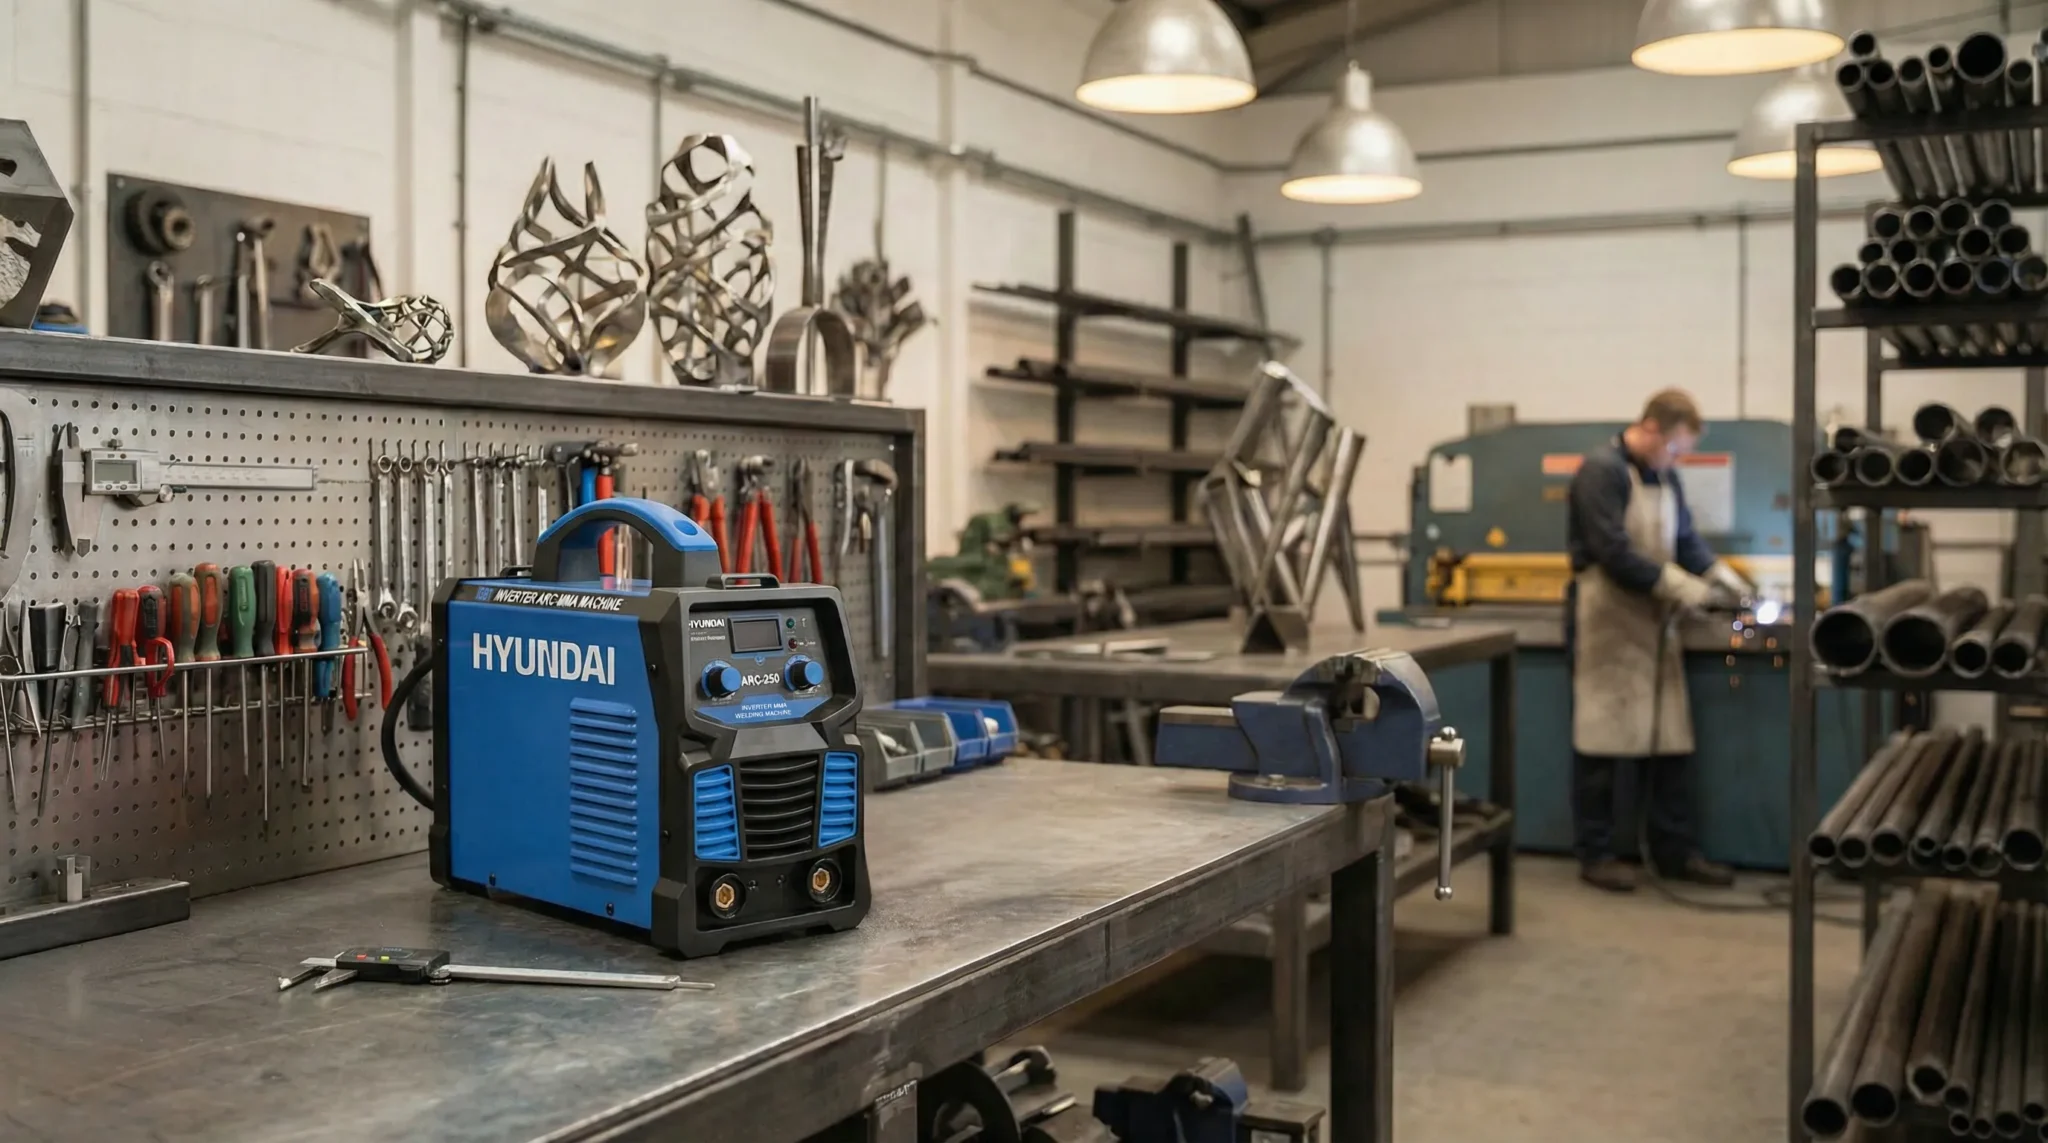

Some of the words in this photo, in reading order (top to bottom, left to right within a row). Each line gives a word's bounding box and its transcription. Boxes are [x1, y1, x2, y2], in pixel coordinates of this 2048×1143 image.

[493, 588, 538, 605] INVERTER
[578, 595, 624, 611] MACHINE
[473, 632, 615, 686] HYUNDAI
[741, 672, 780, 687] ARC-250
[735, 711, 764, 719] WELDING
[765, 709, 792, 717] MACHINE
[741, 703, 772, 711] INVERTER
